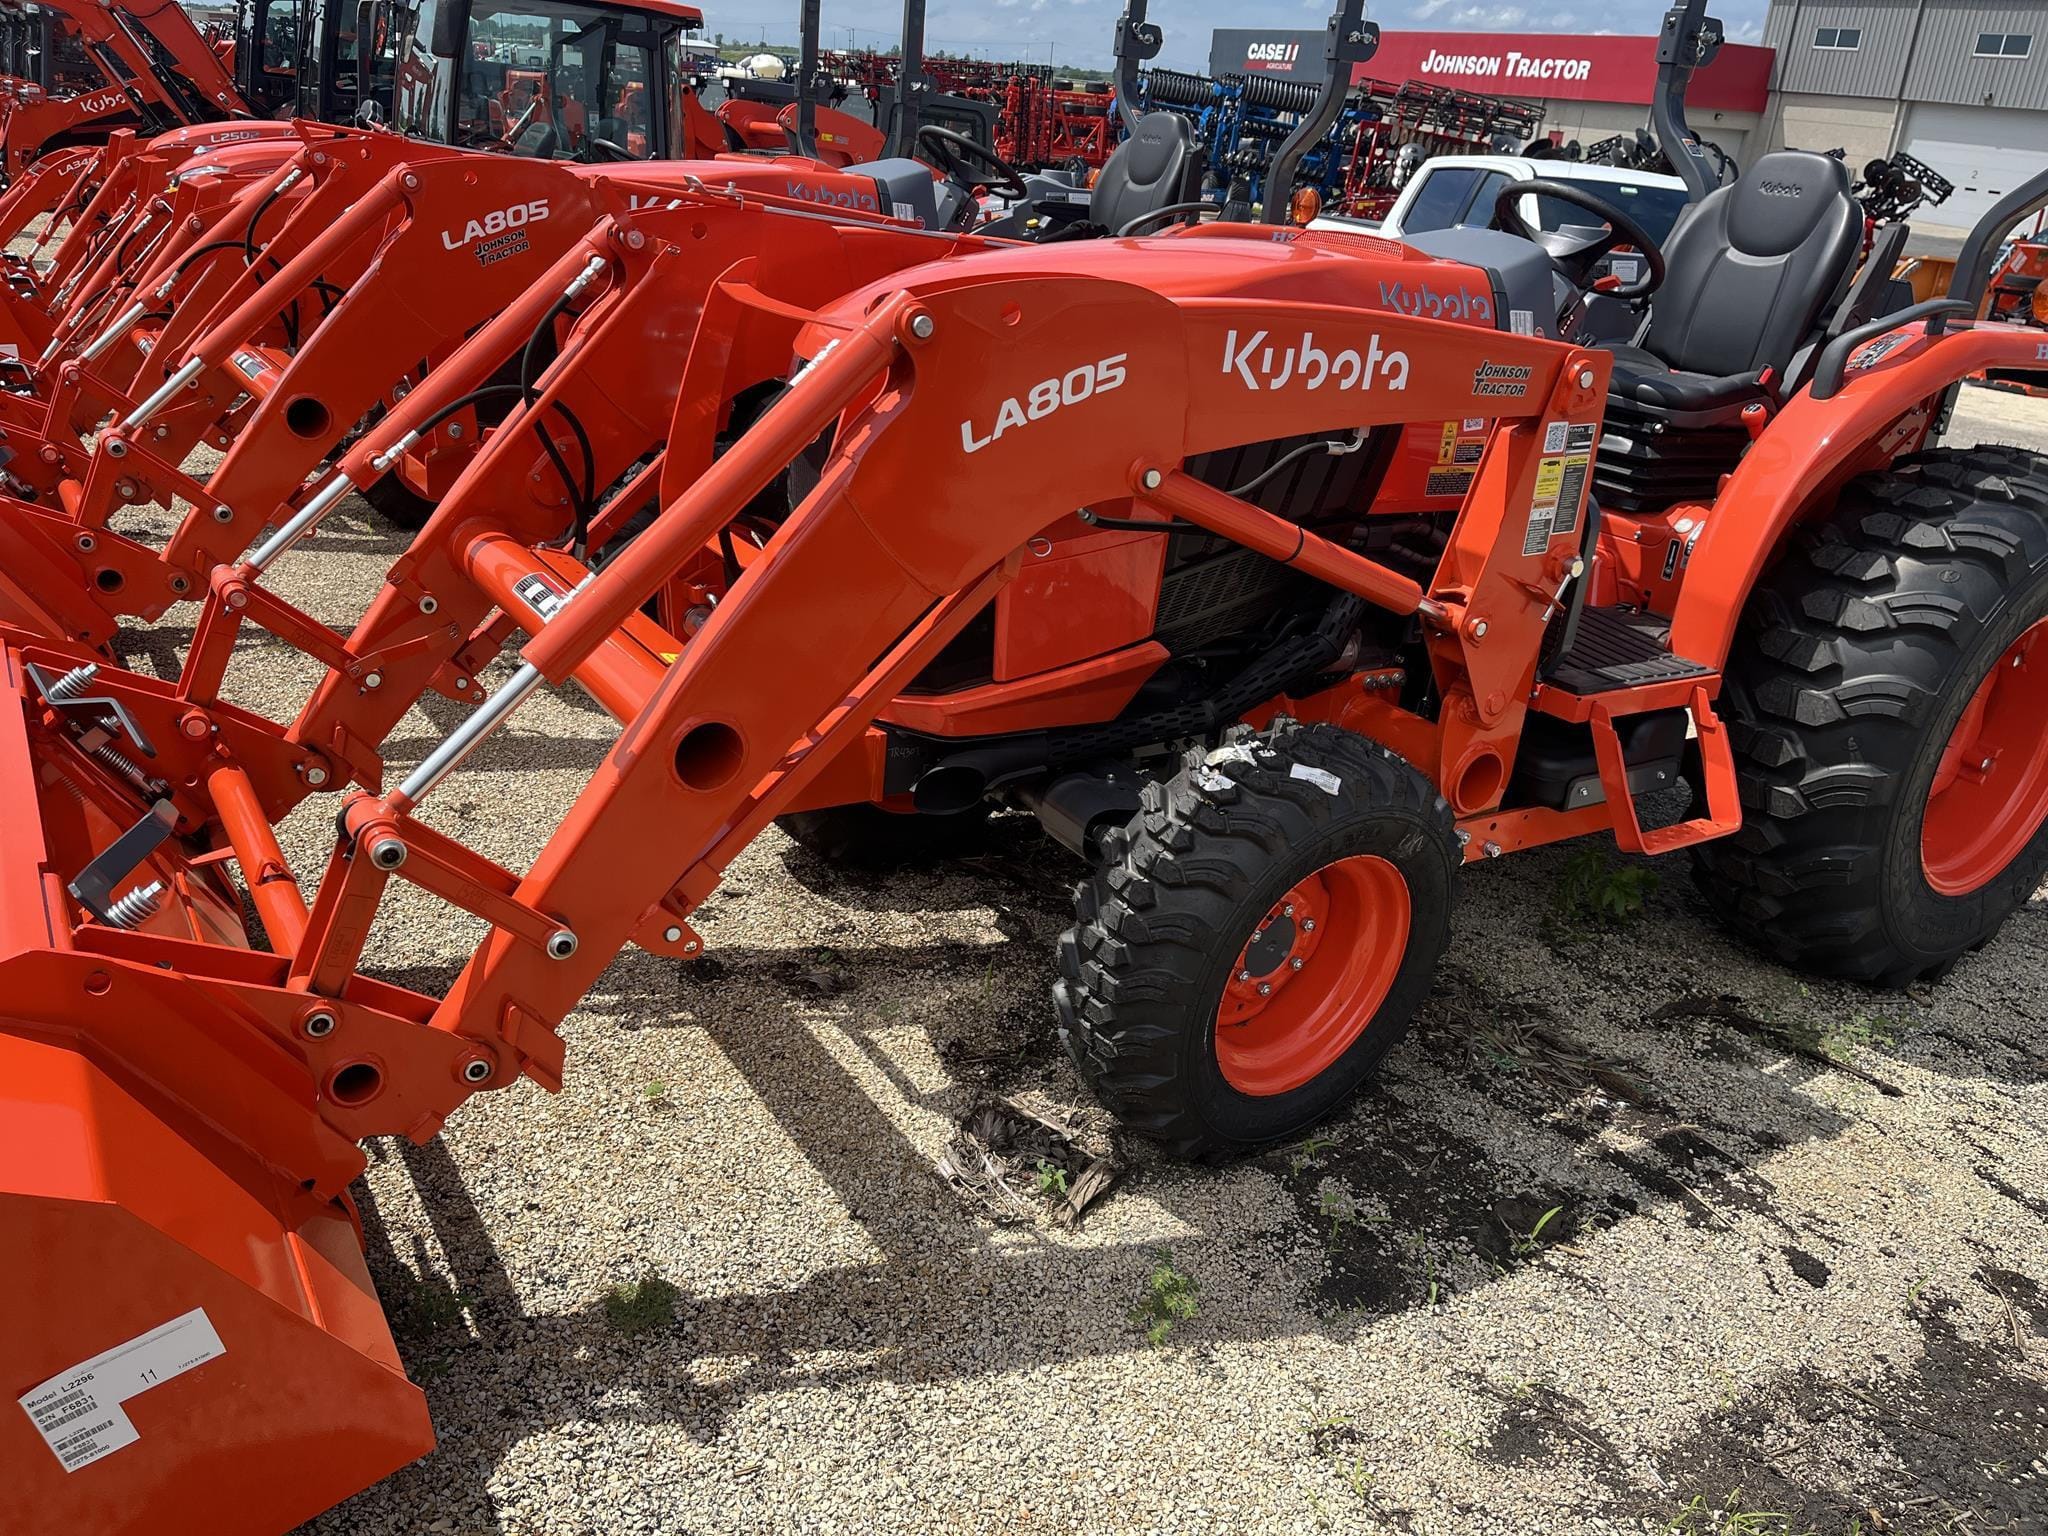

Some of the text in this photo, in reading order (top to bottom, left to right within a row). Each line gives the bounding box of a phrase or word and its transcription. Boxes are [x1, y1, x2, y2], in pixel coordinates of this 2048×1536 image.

[1247, 43, 1285, 60] CASE
[1971, 170, 1978, 179] 2
[787, 181, 876, 210] Kubota
[1760, 180, 1802, 198] Kubota
[441, 199, 550, 251] LA805
[1272, 231, 1296, 241] HS
[1379, 280, 1491, 320] Kubota
[1222, 330, 1410, 391] Kubota
[961, 353, 1128, 453] LA805
[140, 1368, 159, 1384] 11
[27, 1372, 95, 1409] Model L2296
[38, 1412, 56, 1426] S/N
